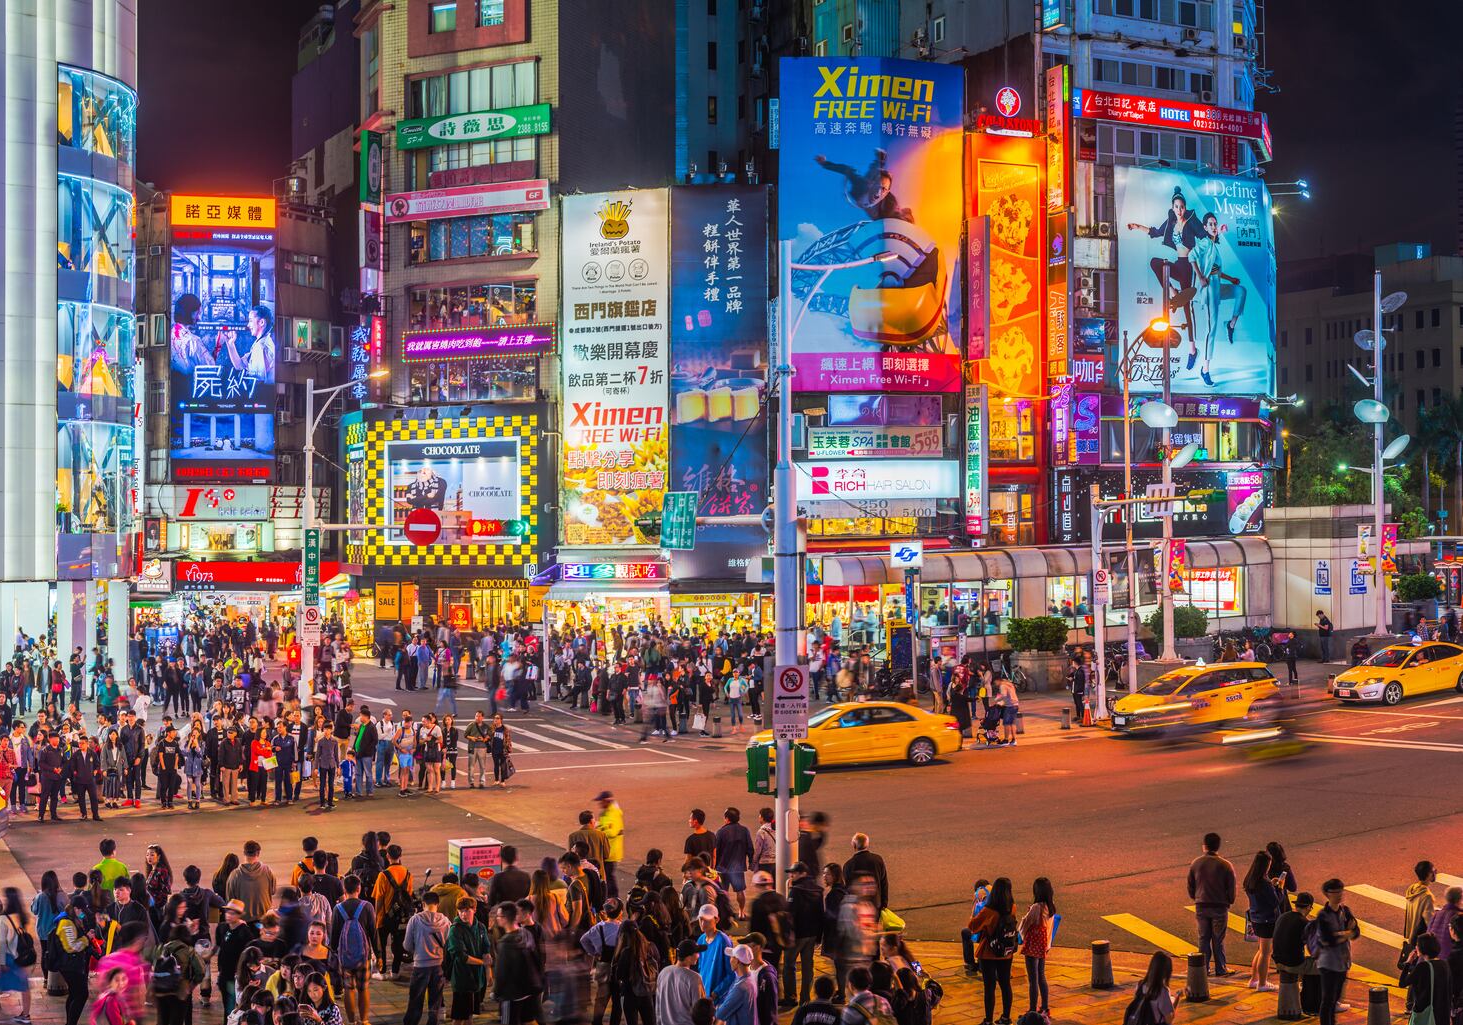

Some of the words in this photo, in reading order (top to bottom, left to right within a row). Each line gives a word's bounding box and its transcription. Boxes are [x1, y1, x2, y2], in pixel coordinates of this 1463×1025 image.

[813, 66, 935, 103] Ximen
[813, 100, 876, 119] FREE
[882, 101, 932, 123] Wi-Fi
[1108, 109, 1122, 118] Diary
[1160, 108, 1190, 121] HOTEL
[439, 116, 505, 137] 詩薇思
[977, 114, 1005, 129] COLD
[814, 122, 873, 135] 高速奔馳
[881, 122, 932, 139] 暢行無礙
[528, 190, 540, 199] 6F
[1214, 180, 1257, 199] Define
[186, 204, 263, 221] 諾亞媒體
[1214, 197, 1258, 219] Myself
[589, 240, 617, 248] Ireland's
[724, 199, 744, 315] 華人世界第一品牌
[573, 341, 658, 361] 歡樂開幕慶
[882, 357, 930, 372] 即刻選擇
[192, 364, 258, 399] 屍約
[568, 366, 664, 387] 飲品第二杯7折
[830, 375, 868, 385] Ximen
[870, 375, 892, 384] Free
[894, 375, 921, 385] Wi-Fi
[570, 402, 663, 427] Ximen
[619, 427, 661, 442] Wi-Fi
[813, 435, 850, 449] 玉芙蓉
[852, 436, 874, 447] SPA
[890, 435, 911, 448] 會館
[568, 450, 635, 469] 點擊分享
[597, 471, 664, 490] 即刻瘋薯
[834, 481, 866, 491] RICH
[866, 480, 892, 491] HAIR
[894, 480, 931, 491] SALON
[858, 500, 889, 509] 250
[902, 508, 932, 518] 5400
[307, 538, 317, 575] 漢中街
[192, 571, 214, 584] 1973
[564, 564, 657, 579] 迎參觀試吃
[1006, 579, 1012, 591] 6
[378, 597, 395, 606] SALE
